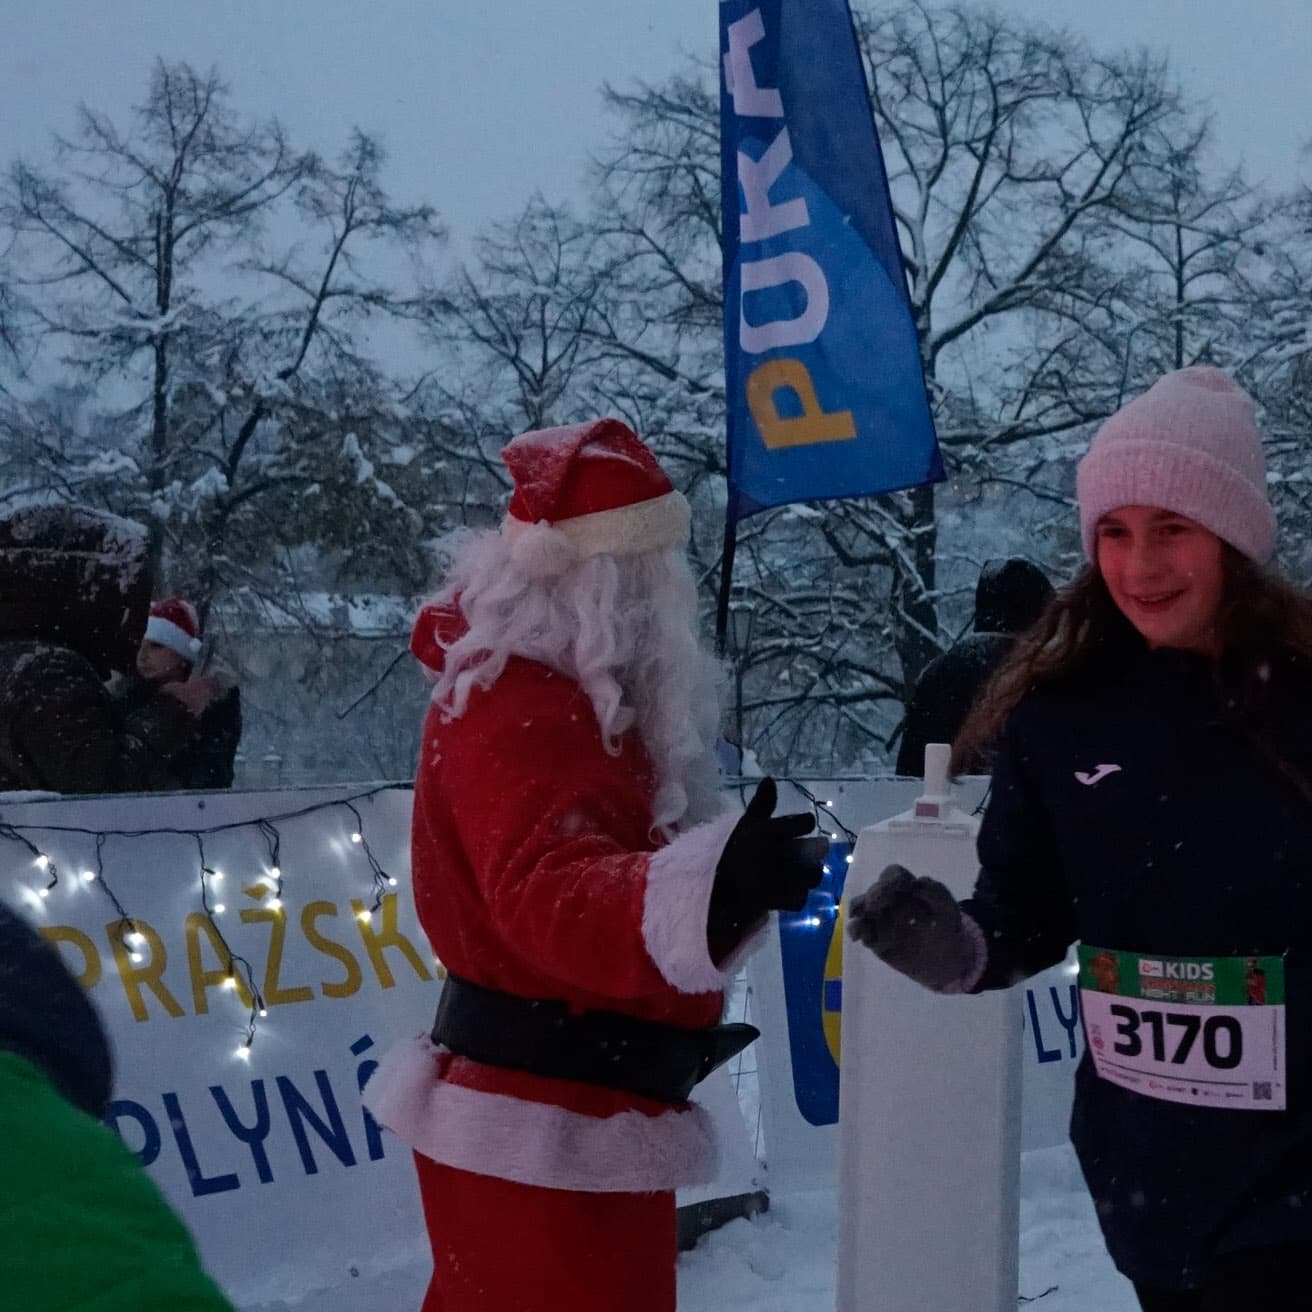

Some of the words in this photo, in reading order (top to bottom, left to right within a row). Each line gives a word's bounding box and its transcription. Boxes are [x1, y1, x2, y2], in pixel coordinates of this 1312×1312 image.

[38, 882, 445, 1022] PRAŽSK
[1165, 961, 1216, 981] KIDS
[1110, 1004, 1243, 1070] 3170
